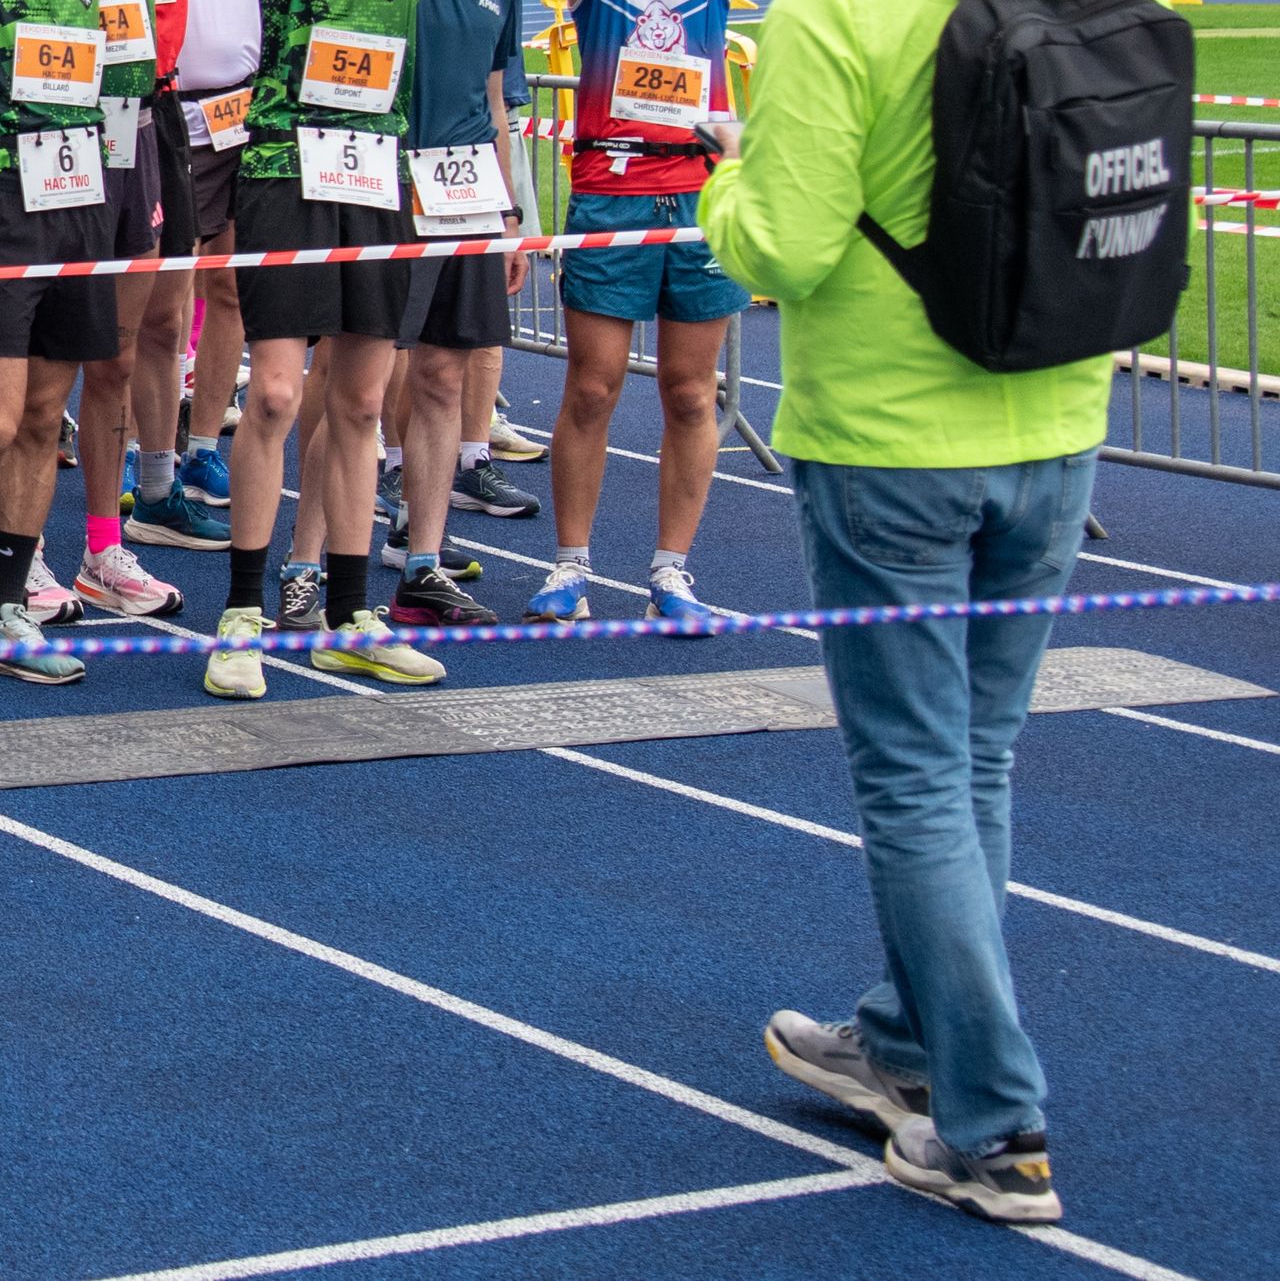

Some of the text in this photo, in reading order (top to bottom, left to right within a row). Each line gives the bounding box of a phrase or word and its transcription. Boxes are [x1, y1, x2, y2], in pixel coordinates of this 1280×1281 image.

[39, 44, 76, 69] 6-A
[332, 49, 372, 76] 5-A
[42, 71, 56, 79] HAC
[332, 75, 346, 84] HAC
[633, 66, 687, 94] 28-A
[42, 83, 70, 92] BILLARD
[334, 87, 362, 98] DUPONT
[617, 88, 637, 97] TEAM
[633, 102, 682, 116] CHRISTOPHER
[58, 145, 74, 172] 6
[343, 145, 359, 171] 5
[433, 159, 479, 187] 423
[1085, 137, 1170, 198] OFFICIEL
[44, 174, 90, 191] HAC TWO
[319, 171, 345, 185] HAC
[348, 174, 384, 191] THREE
[445, 187, 477, 201] KCDQ
